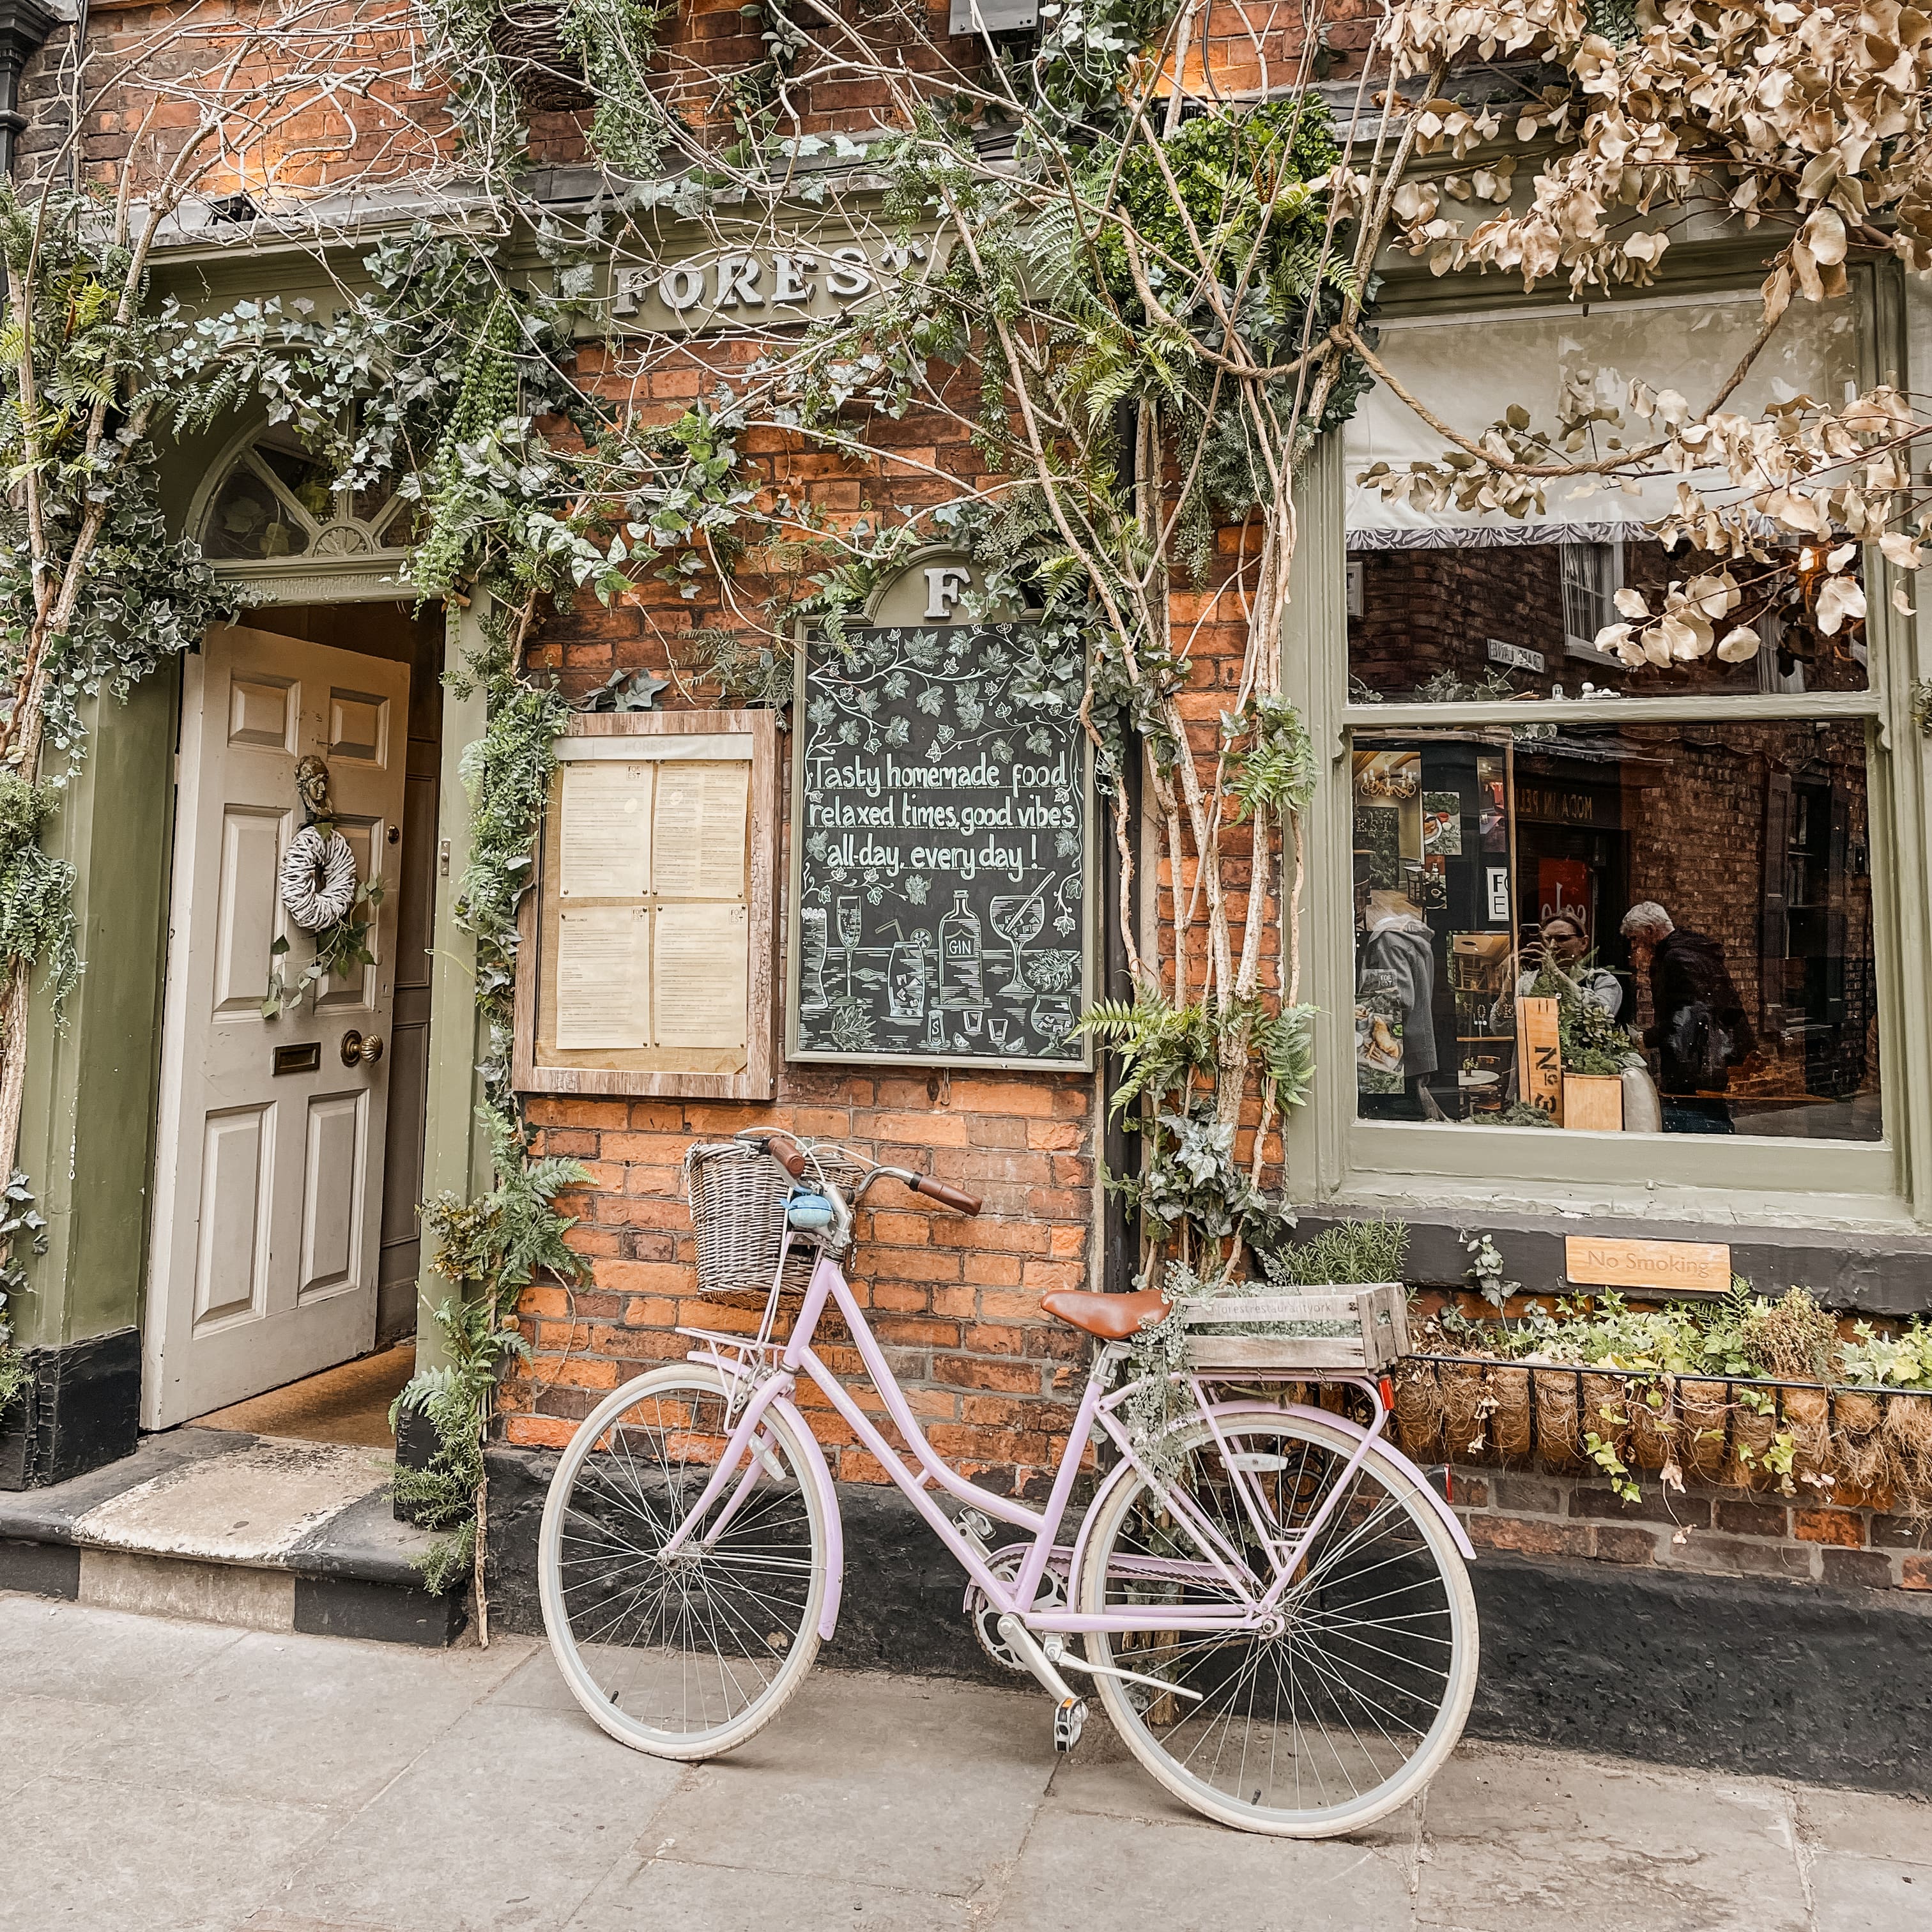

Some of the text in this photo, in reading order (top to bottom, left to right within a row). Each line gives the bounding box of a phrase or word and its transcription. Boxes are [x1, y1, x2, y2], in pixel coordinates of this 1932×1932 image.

[611, 240, 928, 316] FOREST
[924, 566, 972, 618] F
[807, 751, 1068, 798] Tasty homemade food
[809, 795, 895, 827] relaxed
[960, 795, 1013, 836] good
[1016, 794, 1075, 827] vibes
[948, 939, 972, 956] GIN
[931, 1020, 939, 1036] S
[1588, 1250, 1710, 1278] No Smoking
